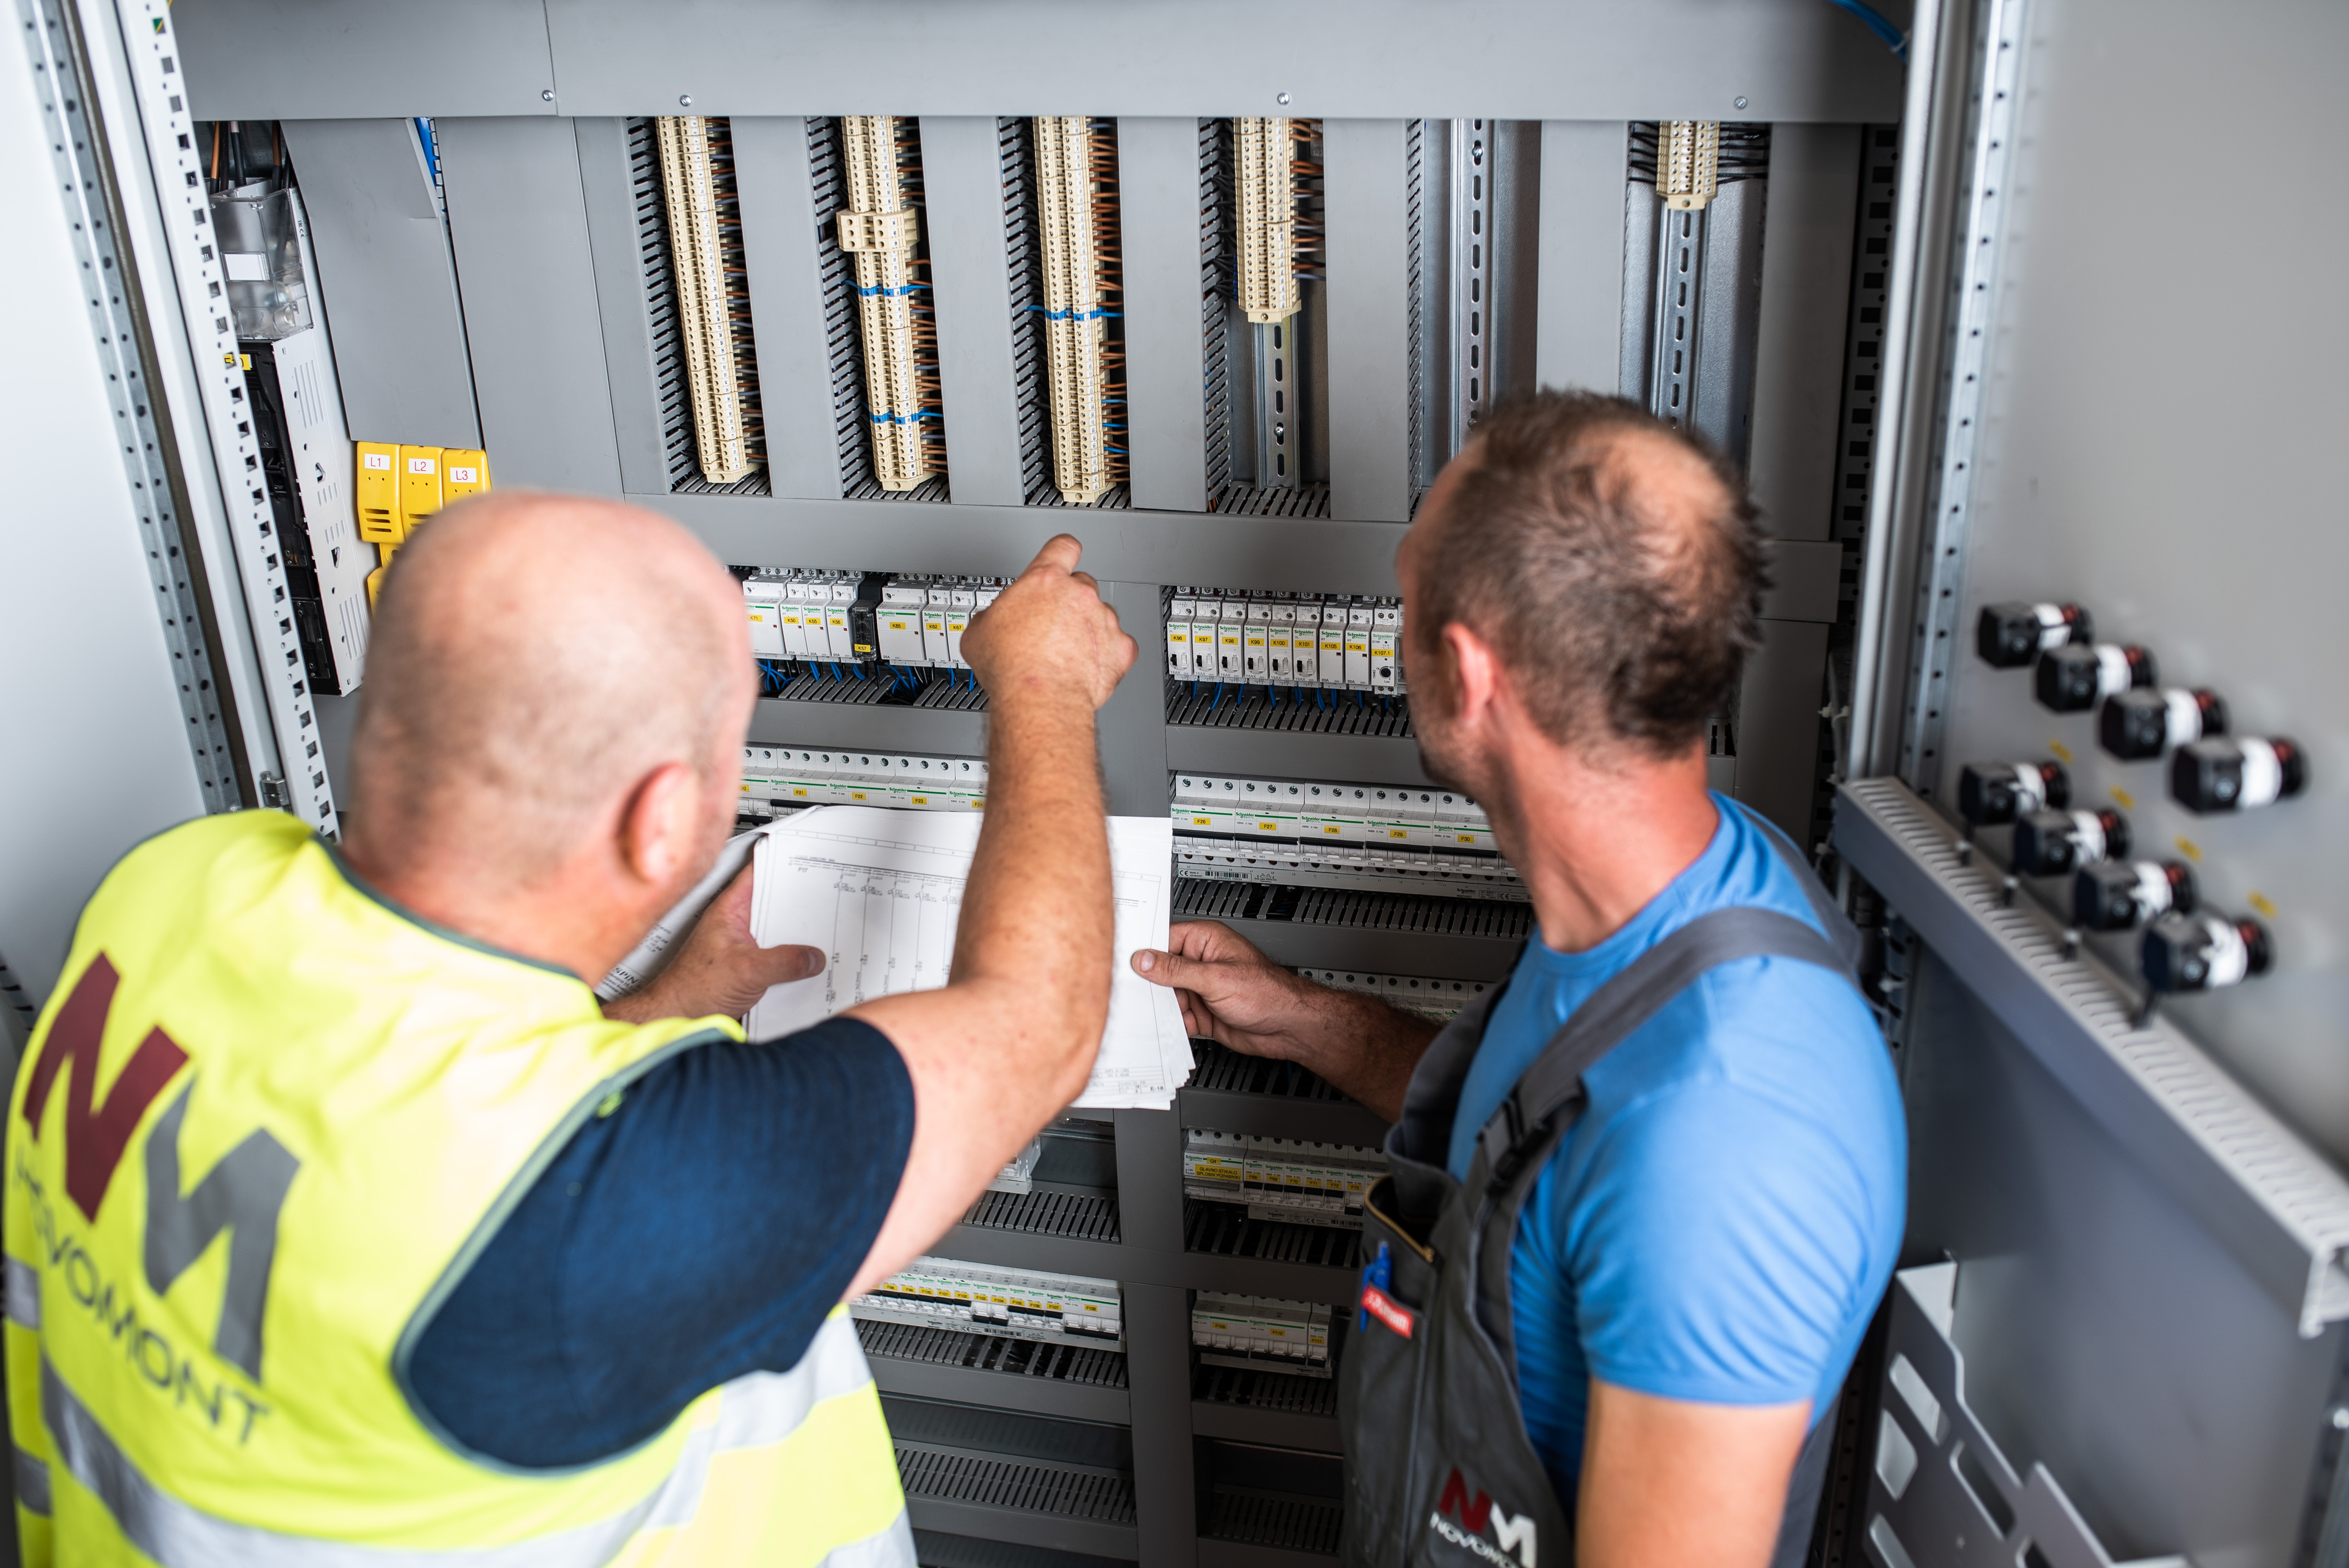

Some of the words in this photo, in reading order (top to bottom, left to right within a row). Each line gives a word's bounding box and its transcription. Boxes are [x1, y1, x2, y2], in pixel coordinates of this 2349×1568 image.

[371, 457, 381, 467] L1
[414, 461, 426, 471] L2
[456, 470, 468, 480] L3
[1430, 1511, 1519, 1568] NOVOMO
